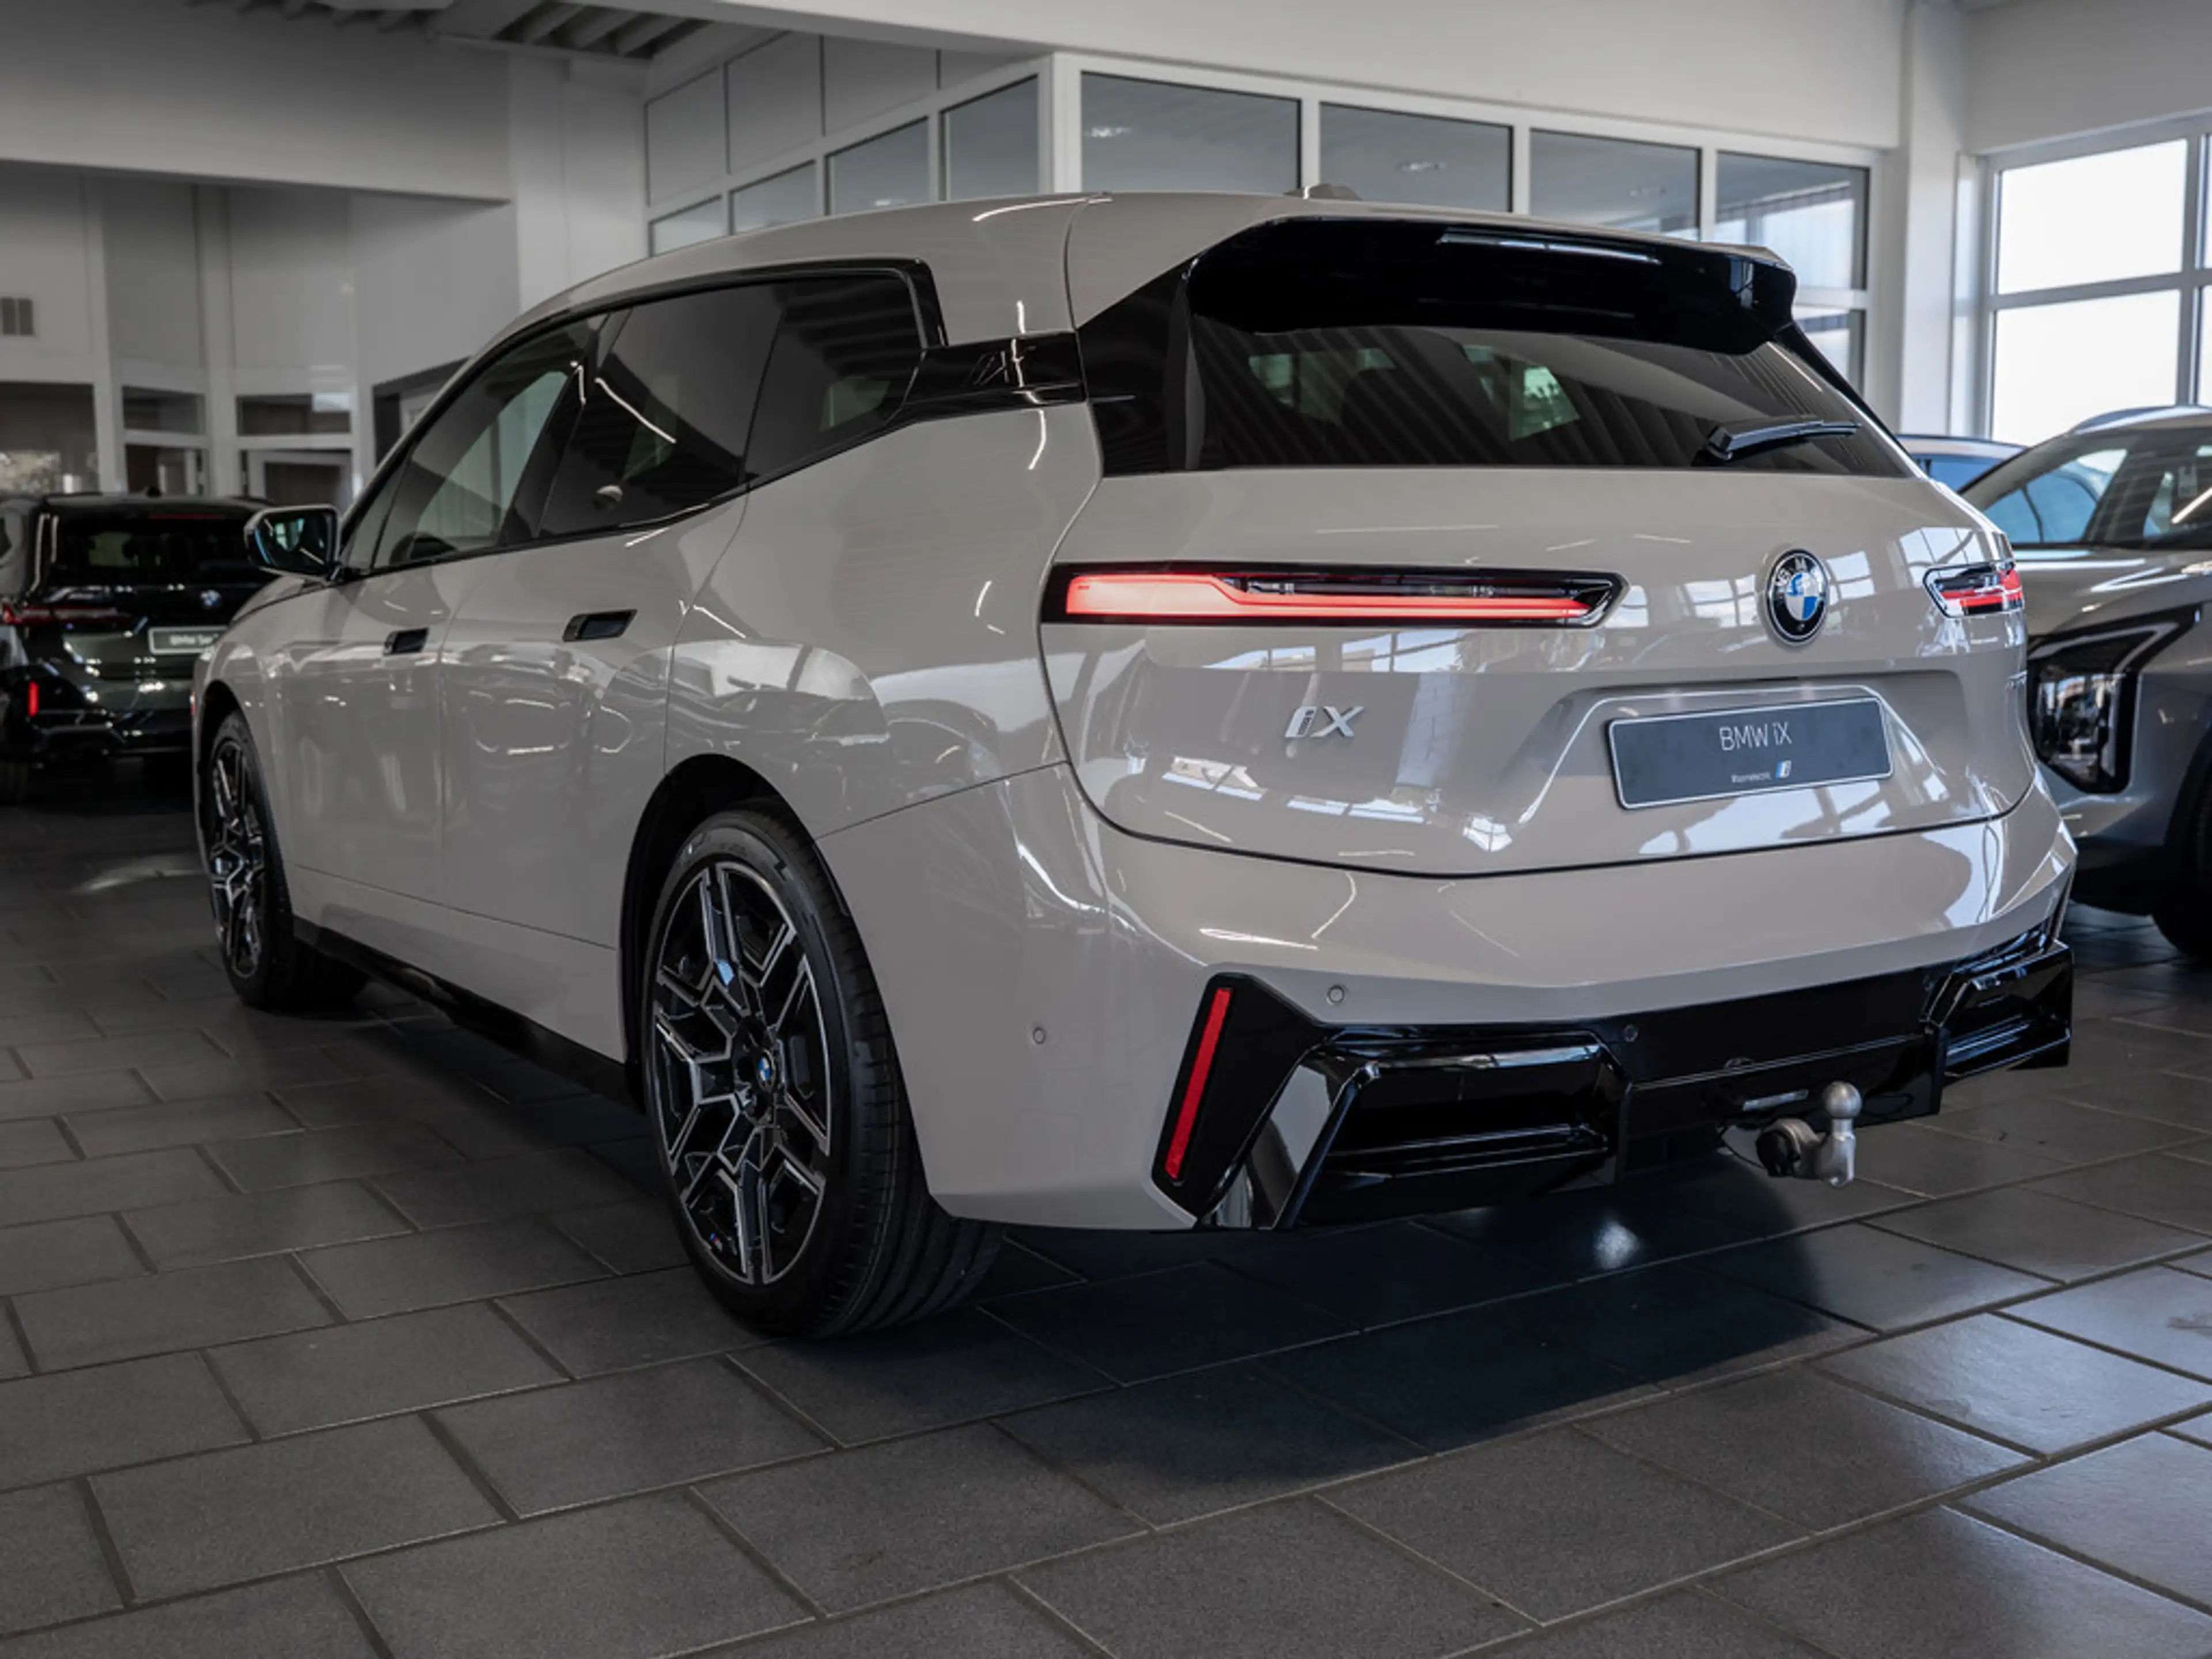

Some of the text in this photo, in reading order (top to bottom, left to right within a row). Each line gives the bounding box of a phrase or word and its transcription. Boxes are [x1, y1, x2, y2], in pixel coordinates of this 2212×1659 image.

[1285, 706, 1364, 738] iX
[1719, 721, 1792, 751] BMW iX
